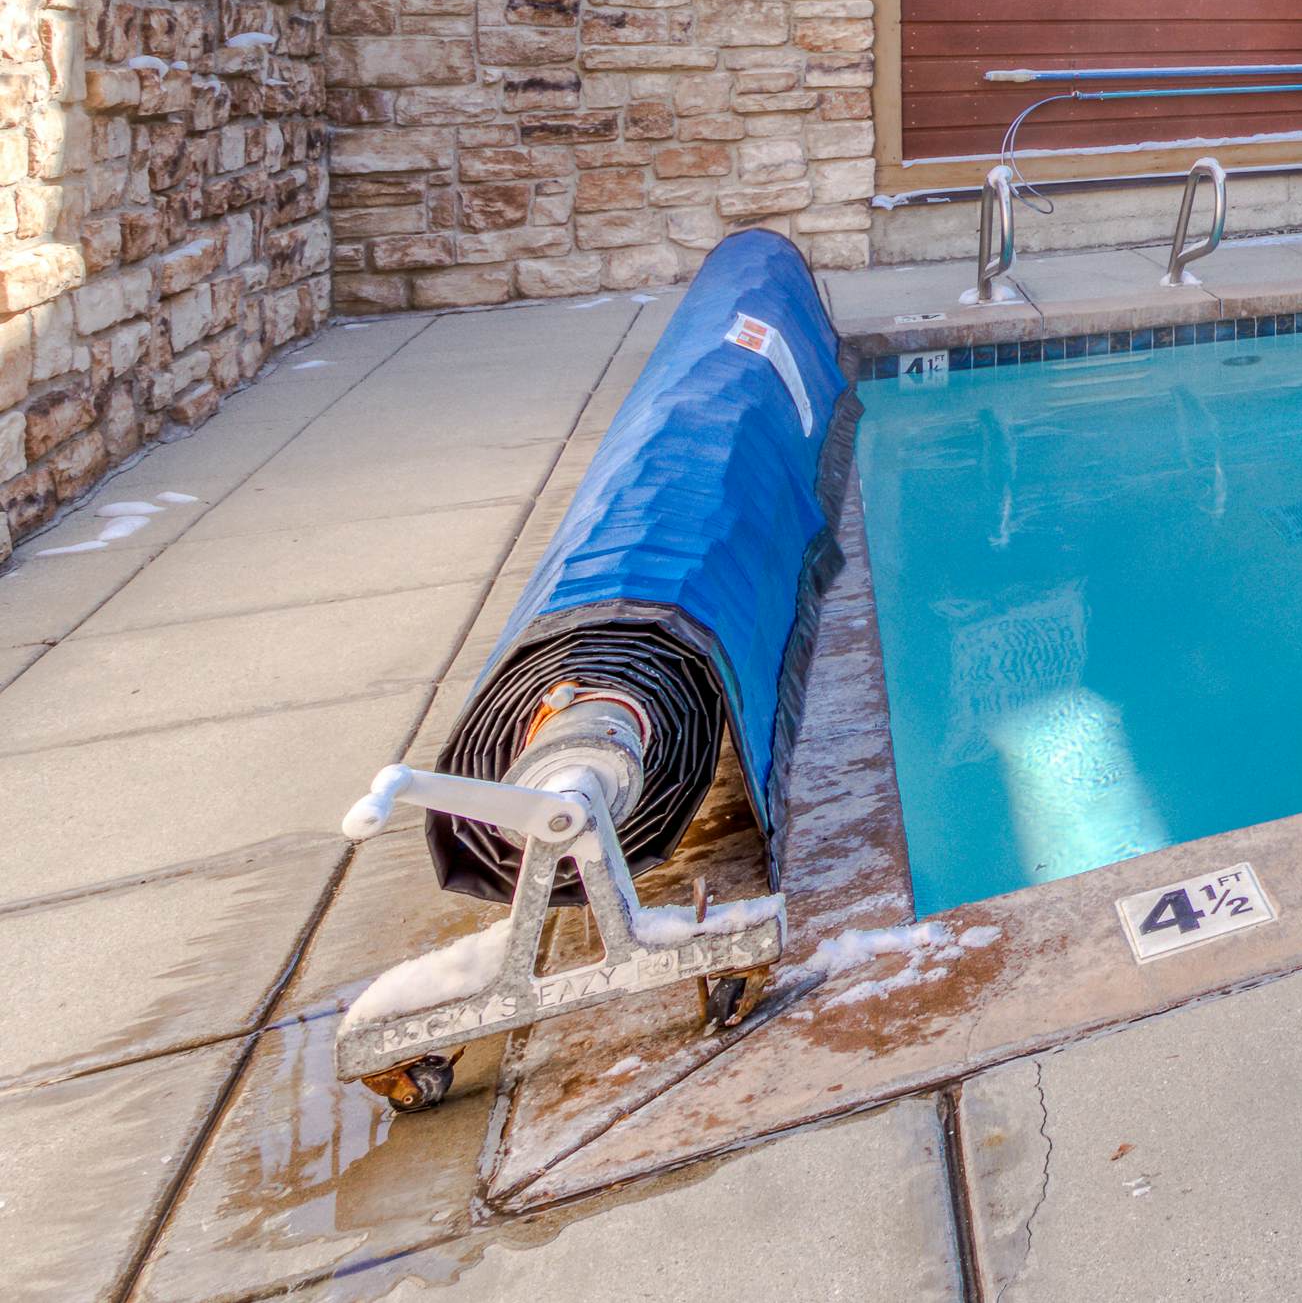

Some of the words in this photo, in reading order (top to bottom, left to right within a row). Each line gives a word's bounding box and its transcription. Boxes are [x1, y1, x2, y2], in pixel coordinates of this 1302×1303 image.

[934, 354, 945, 362] FT
[1217, 871, 1243, 886] FT
[538, 966, 617, 1006] EAZY
